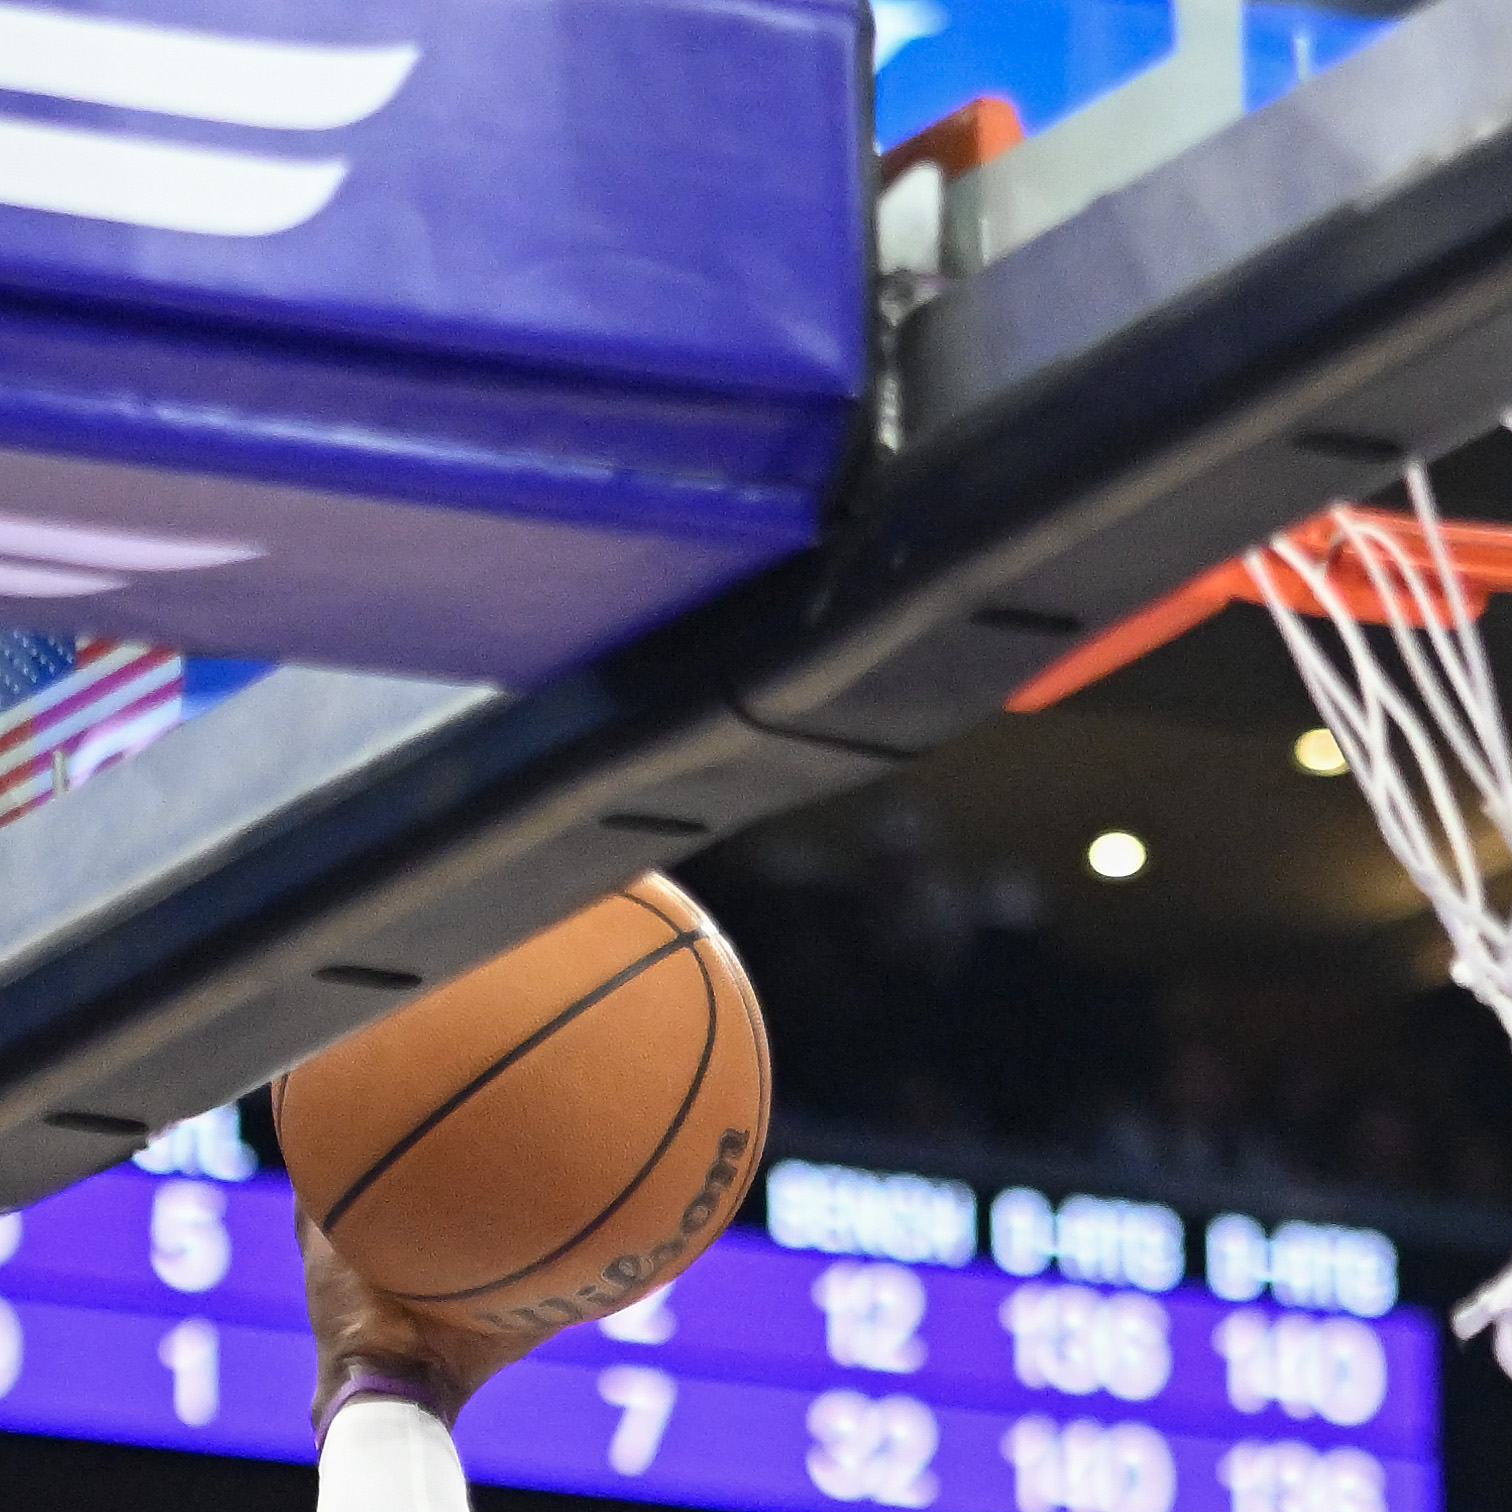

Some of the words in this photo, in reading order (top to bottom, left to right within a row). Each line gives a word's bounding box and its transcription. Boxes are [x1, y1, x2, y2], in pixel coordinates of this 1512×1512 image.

[149, 1179, 231, 1293] 5
[812, 1262, 928, 1374] 12
[1212, 1309, 1388, 1427] 140
[158, 1318, 220, 1426] 1
[598, 1364, 678, 1477] 7
[805, 1390, 941, 1509] 32
